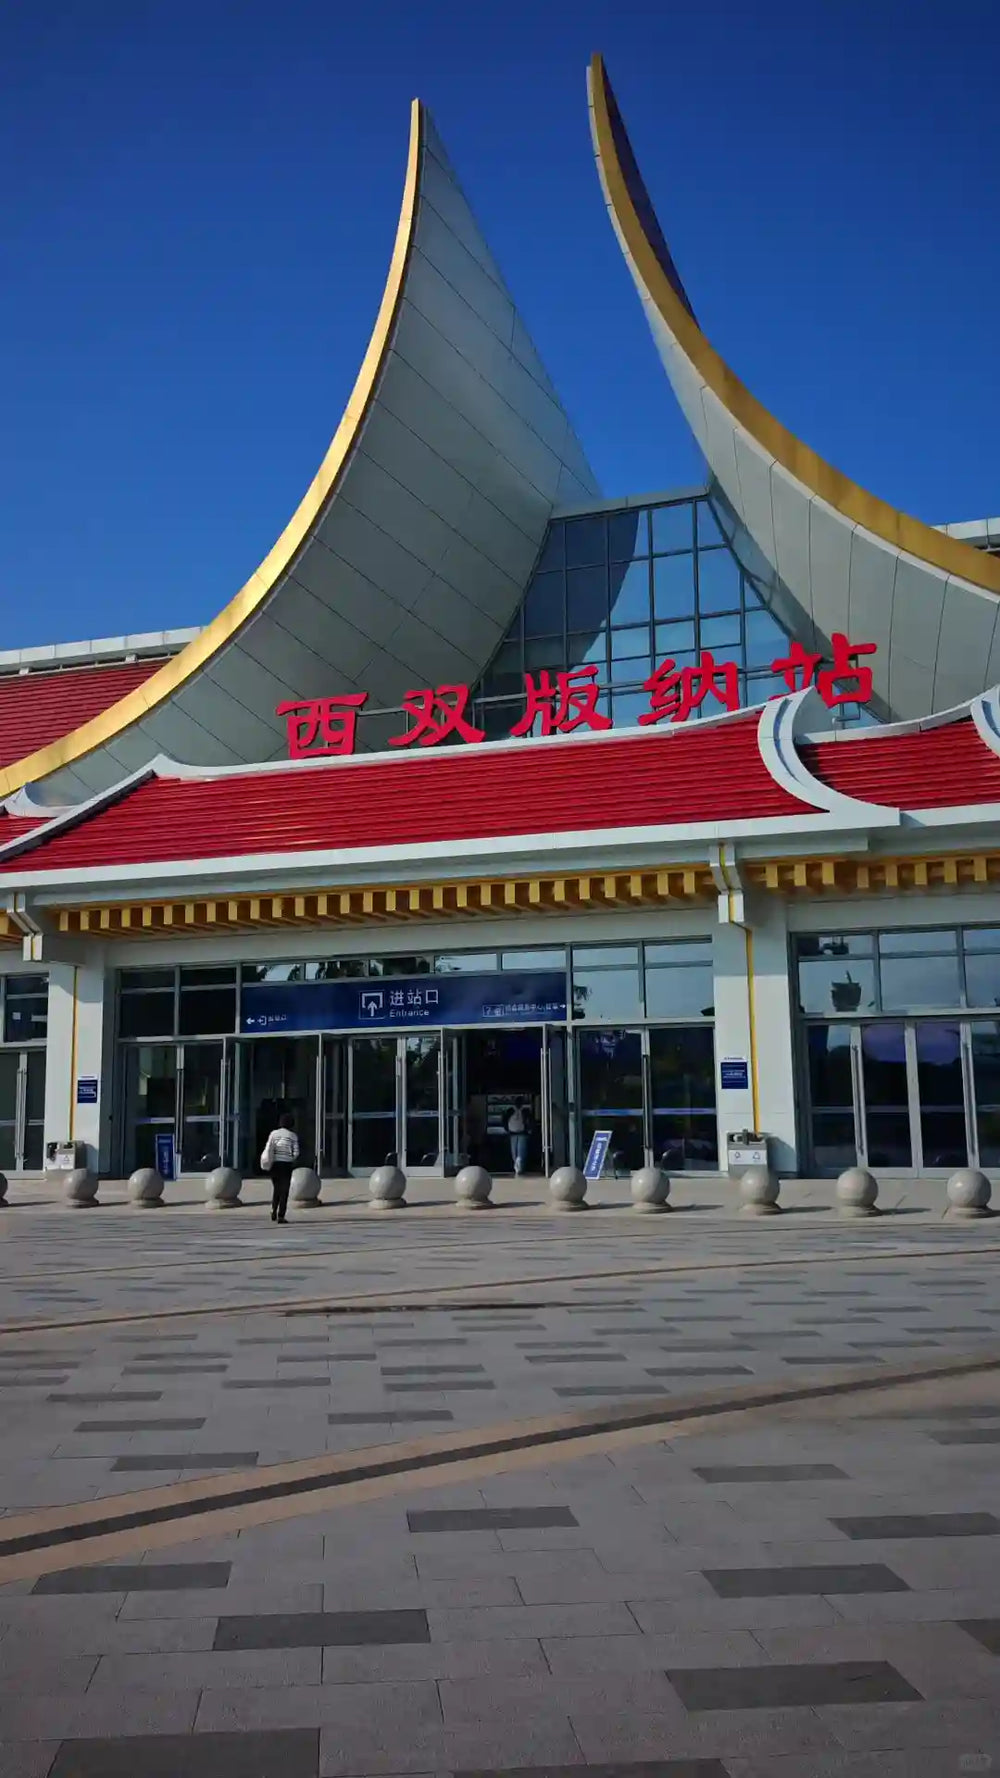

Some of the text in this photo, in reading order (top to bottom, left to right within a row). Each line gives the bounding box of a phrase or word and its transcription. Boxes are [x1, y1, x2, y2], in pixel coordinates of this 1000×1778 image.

[277, 633, 877, 759] 西双版纳站
[390, 989, 438, 1005] 进站口
[389, 1009, 429, 1017] Entrance
